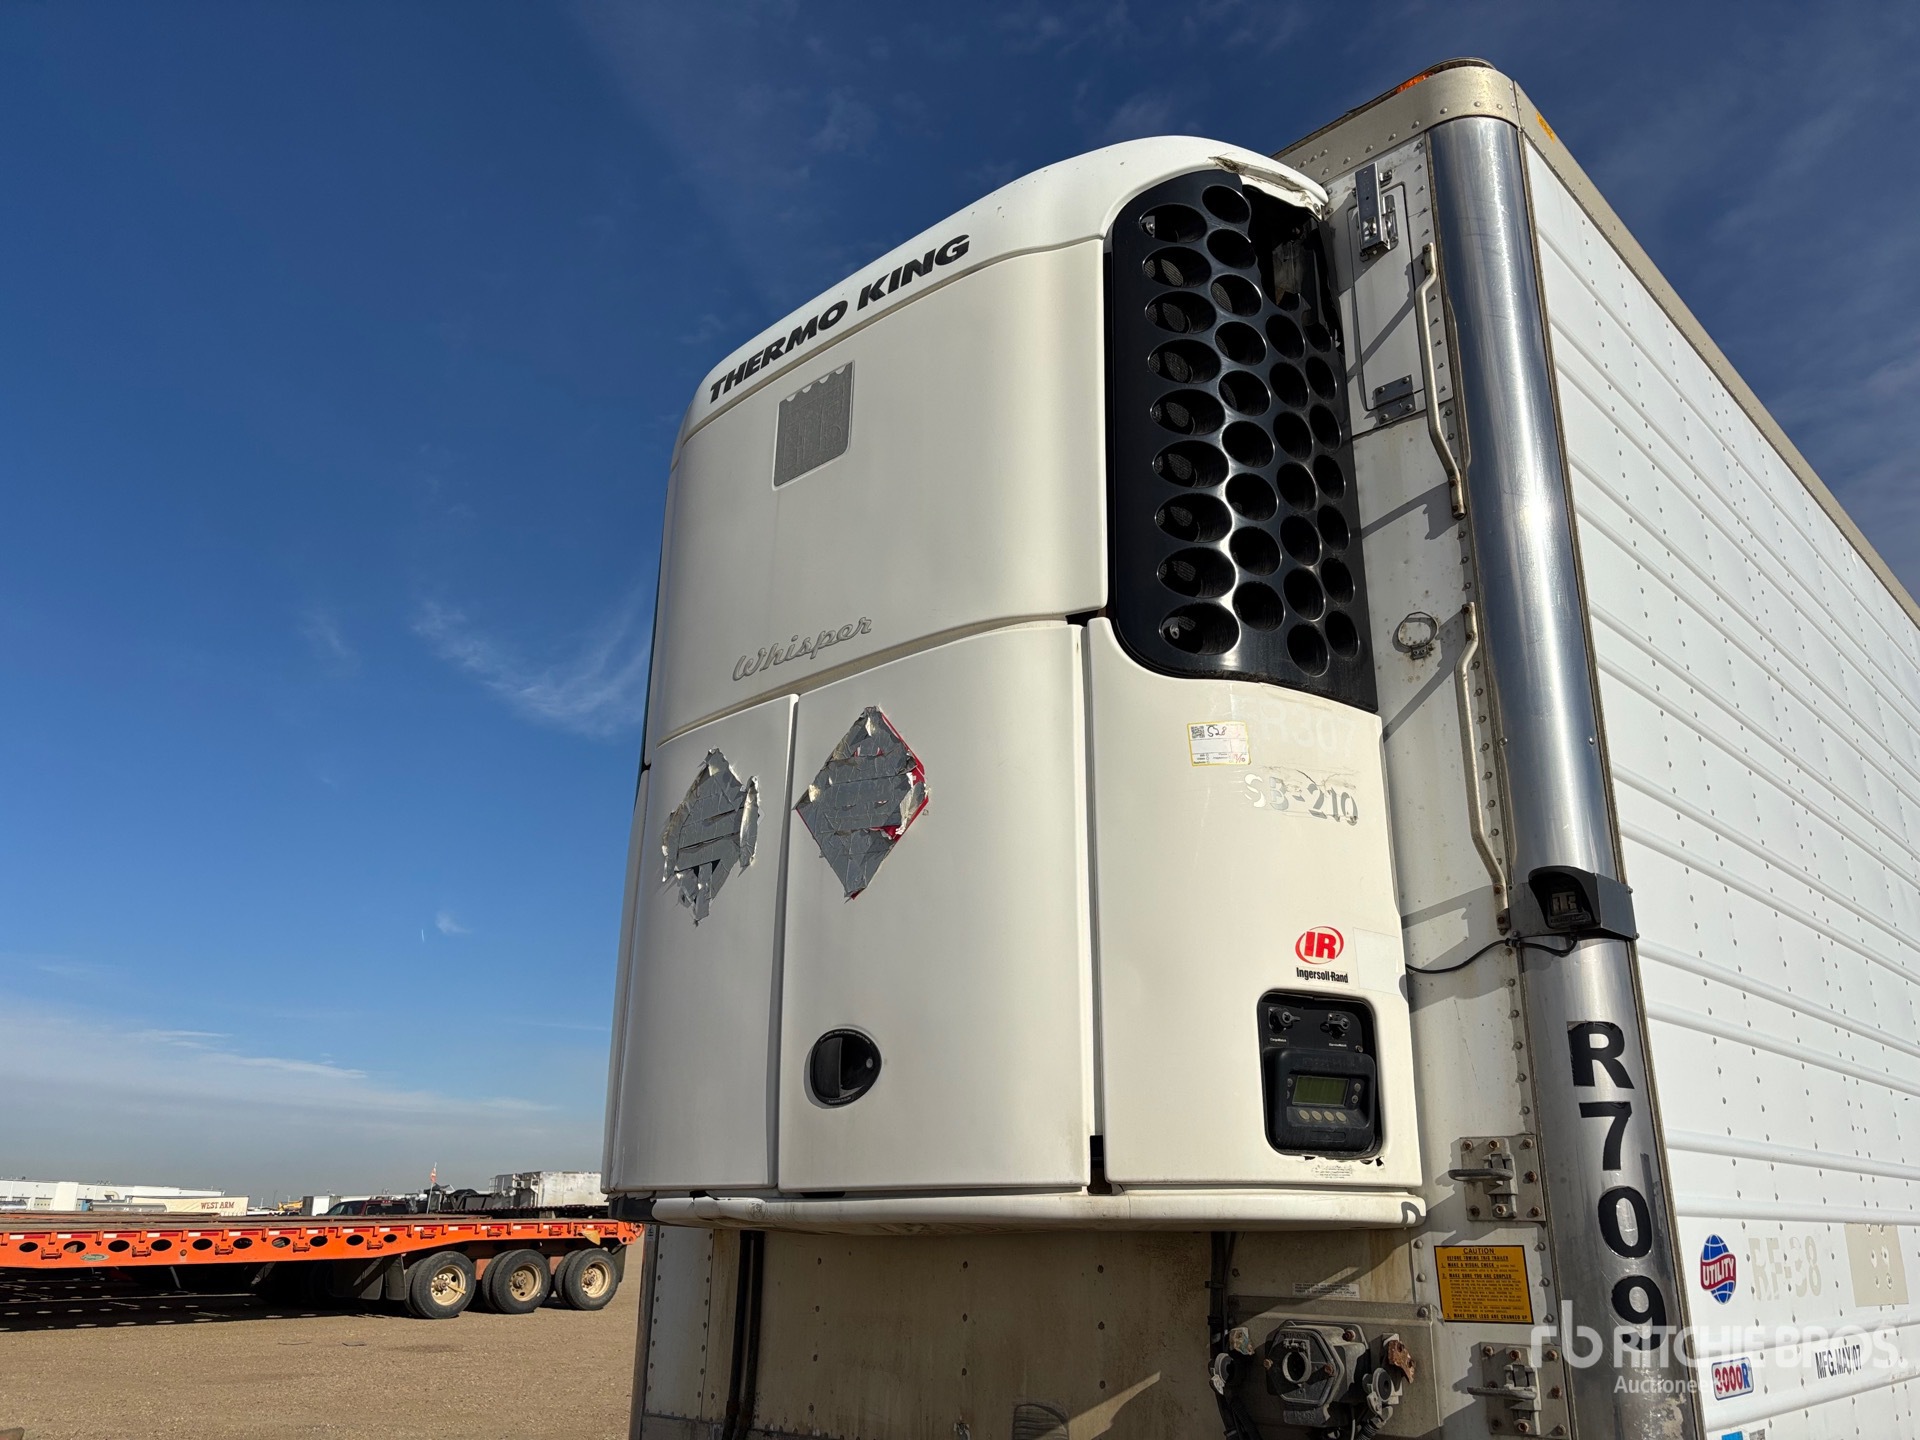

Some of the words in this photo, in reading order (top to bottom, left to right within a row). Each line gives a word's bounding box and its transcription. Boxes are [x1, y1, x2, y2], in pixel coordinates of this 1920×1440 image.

[709, 300, 849, 404] THERMO
[856, 234, 970, 312] KING
[732, 616, 872, 681] Whisper
[1304, 931, 1336, 960] IR
[200, 1201, 219, 1210] WEST
[1463, 1247, 1495, 1255] CAUTION
[1702, 1257, 1735, 1287] UTILITY
[1714, 1362, 1751, 1394] 3000R
